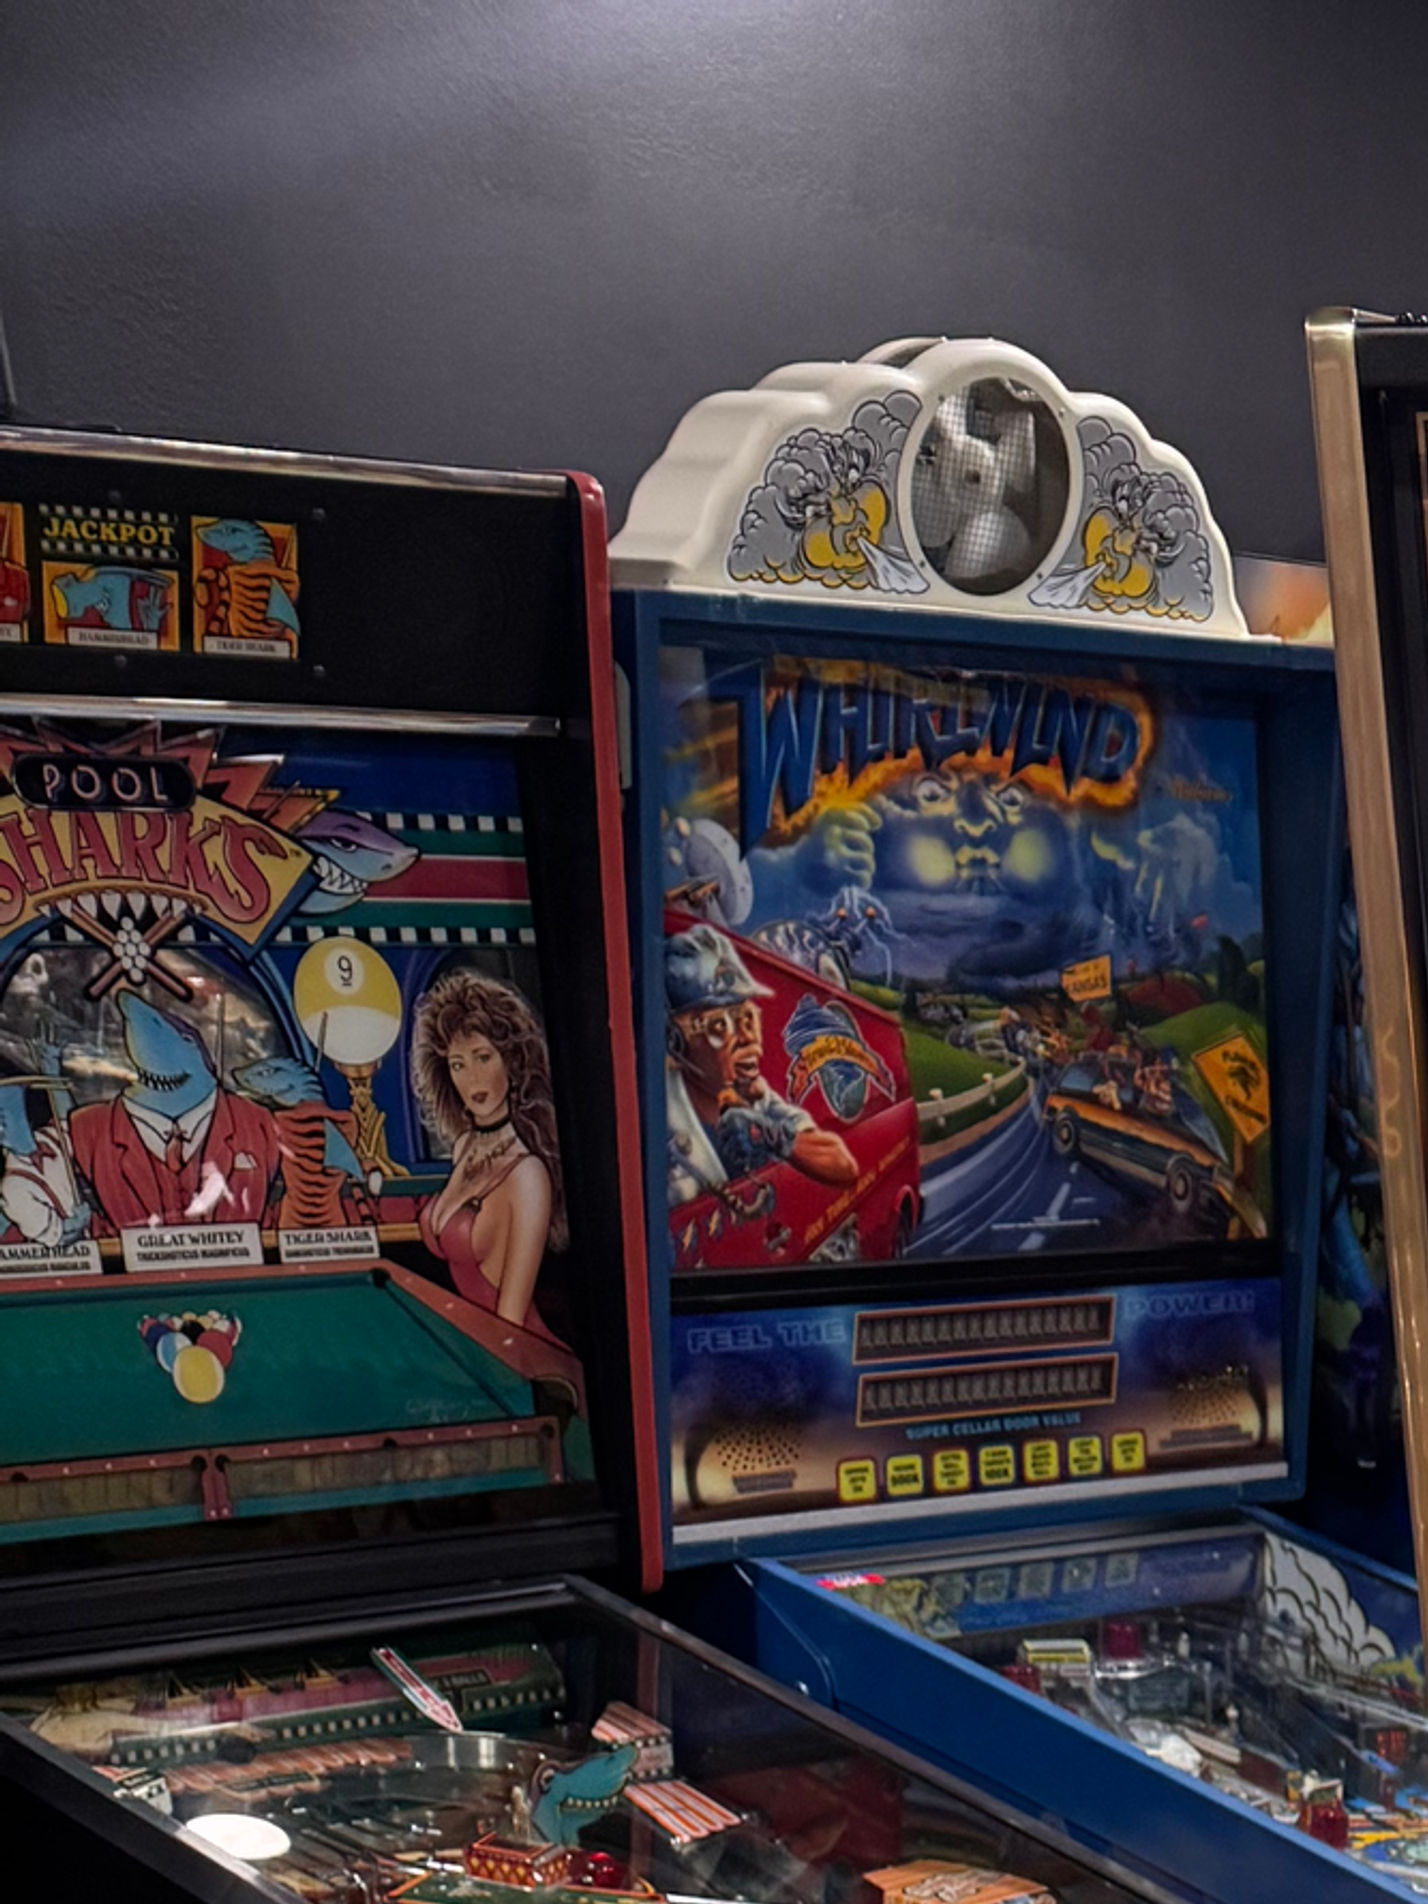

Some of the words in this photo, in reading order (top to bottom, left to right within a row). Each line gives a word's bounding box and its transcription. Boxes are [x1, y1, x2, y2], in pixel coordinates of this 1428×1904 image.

[43, 517, 174, 546] JACKPOT
[737, 664, 1140, 862] WHIRLWIND
[43, 763, 169, 800] POOL
[337, 956, 353, 986] 9
[138, 1233, 185, 1247] GREAT
[187, 1230, 244, 1245] WHITEY
[285, 1234, 324, 1246] TIGER
[327, 1231, 372, 1244] SHARK
[688, 1325, 772, 1355] FEEL
[777, 1319, 847, 1345] THE
[1124, 1290, 1254, 1320] POWER!
[906, 1425, 949, 1440] SUPER
